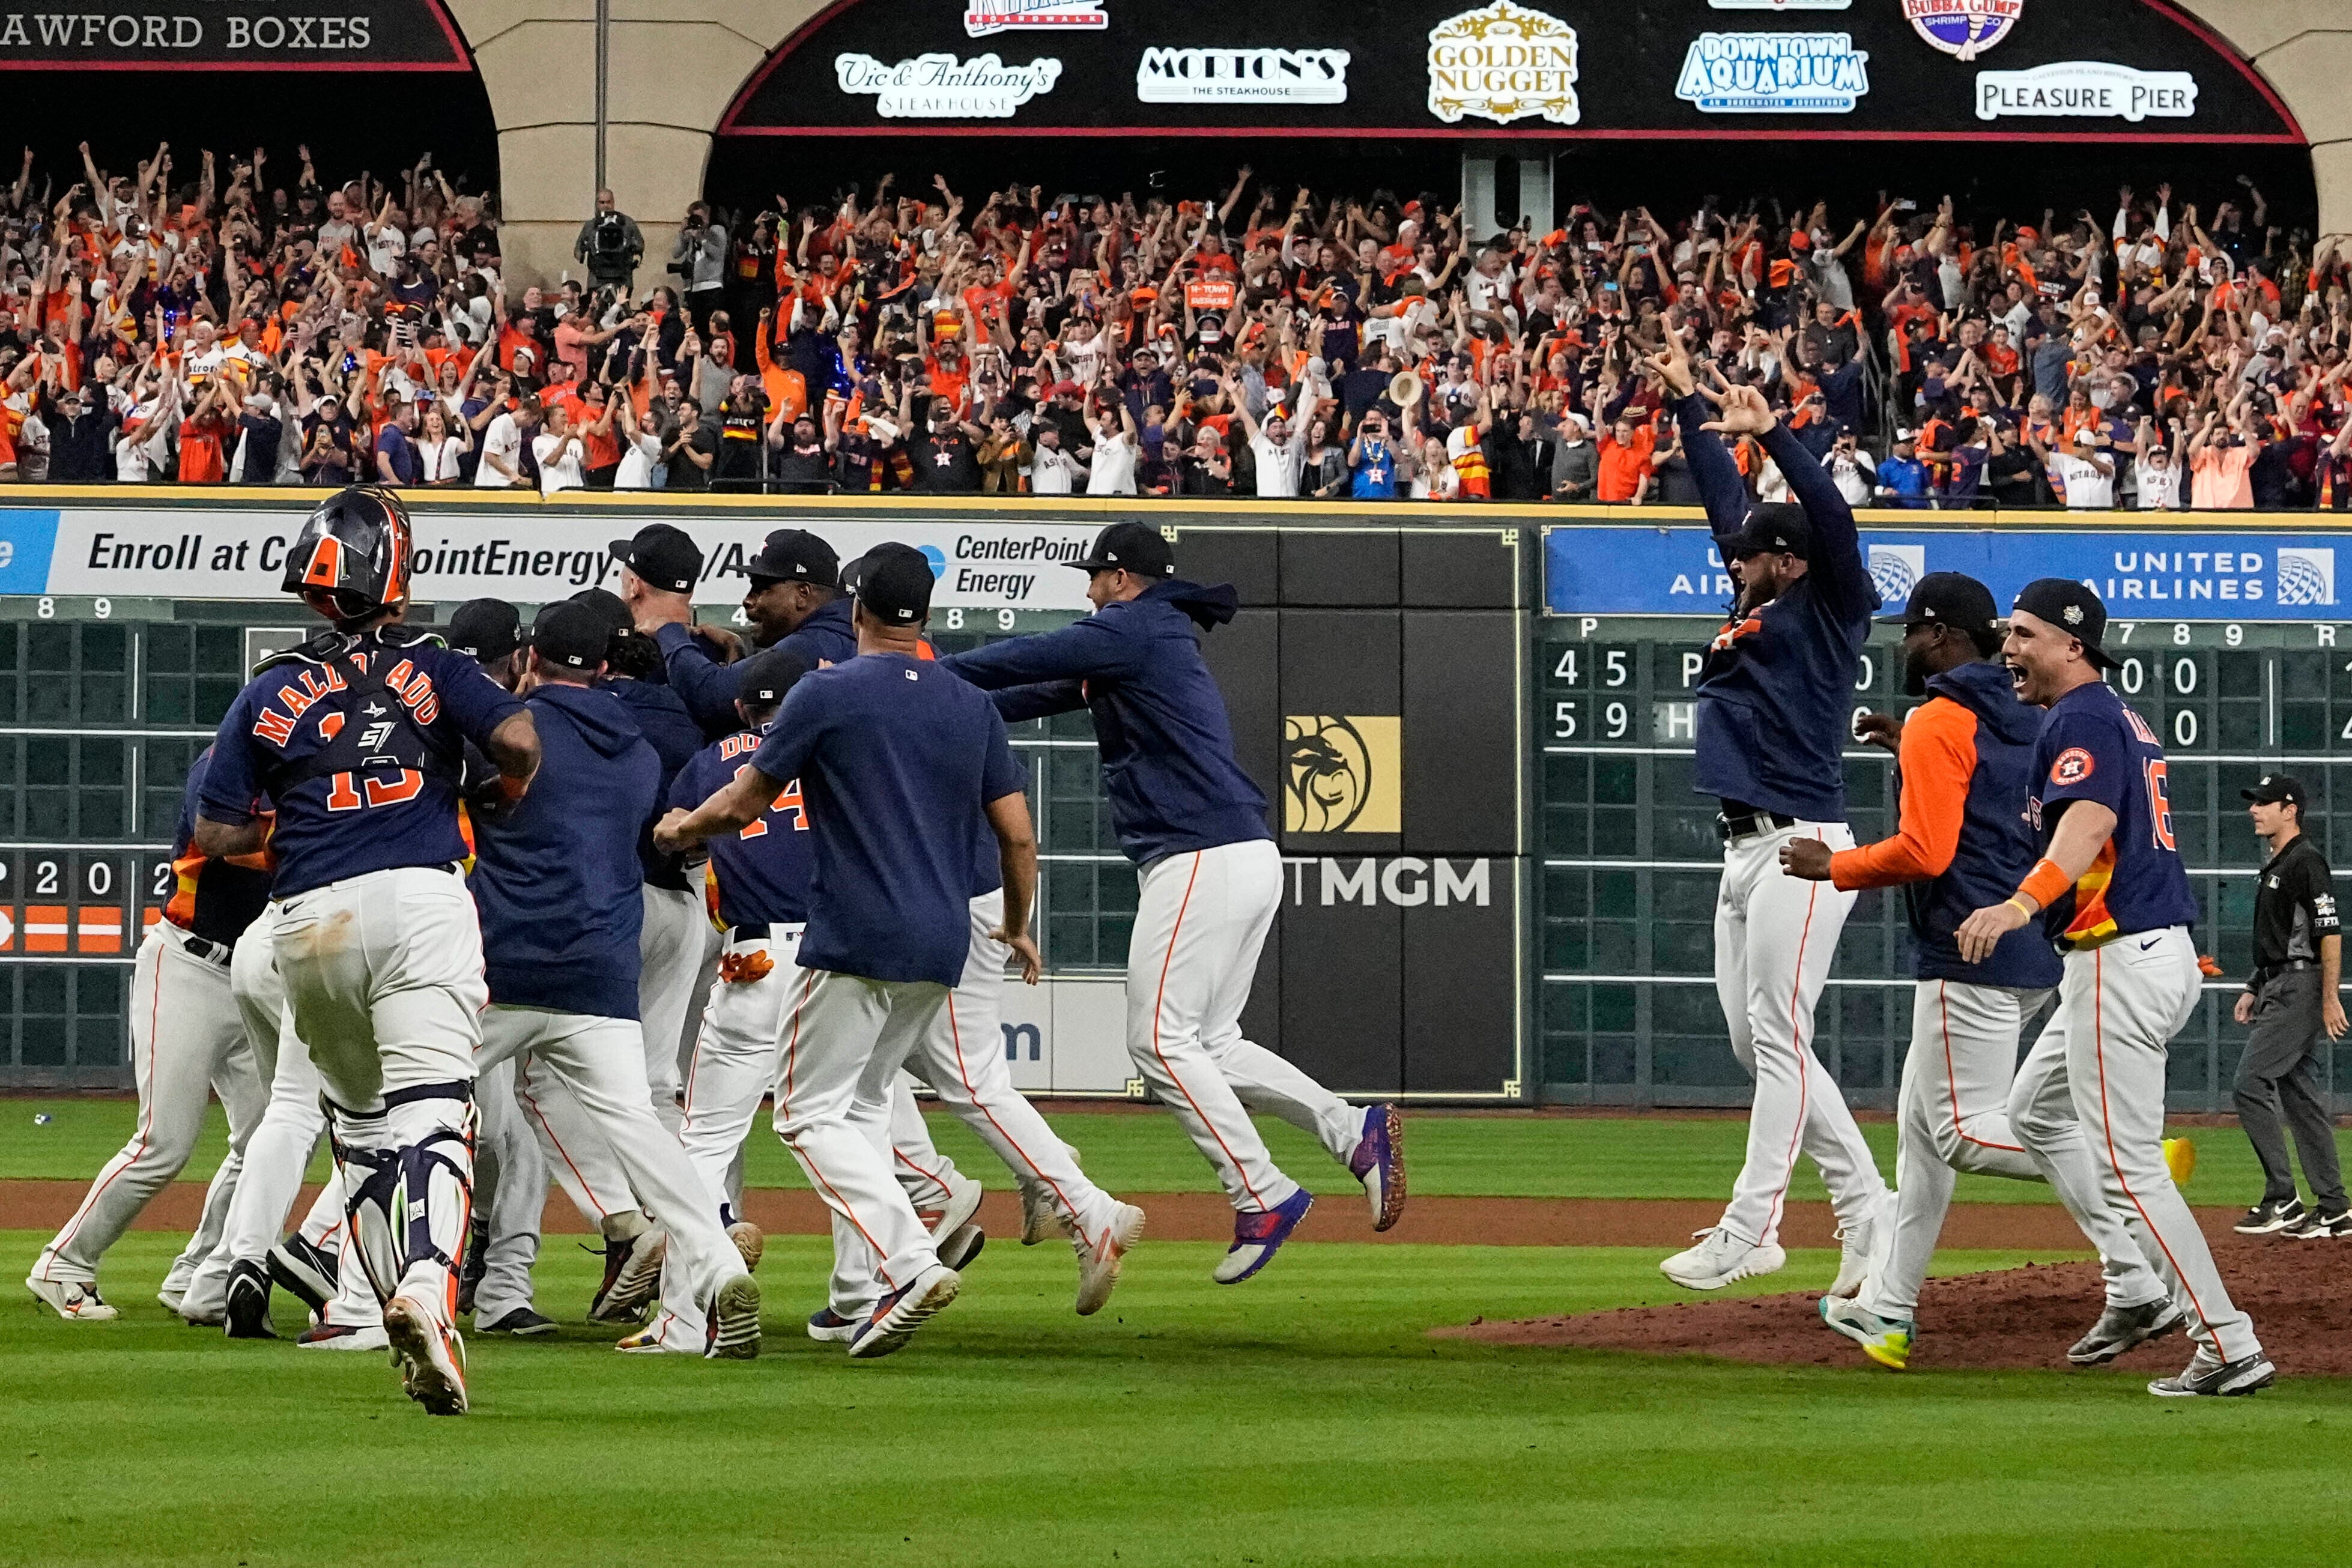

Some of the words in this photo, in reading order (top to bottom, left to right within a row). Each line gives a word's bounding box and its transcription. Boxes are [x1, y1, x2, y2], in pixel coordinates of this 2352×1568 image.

[226, 16, 370, 48] BOXES
[1924, 16, 1967, 26] SHRIMP
[1433, 45, 1572, 68] GOLDEN
[1703, 37, 1847, 61] DOWNTOWN
[842, 60, 887, 86] Vic
[893, 65, 912, 86] &
[917, 61, 1049, 98] Anthony's
[1144, 55, 1336, 80] MORTON'S
[1680, 44, 1865, 97] AQUARIUM
[1193, 87, 1213, 95] THE
[1217, 87, 1291, 96] STEAKHOUSE
[1435, 69, 1572, 92] NUGGET
[884, 96, 1010, 111] STEAKHOUSE
[1984, 84, 2113, 112] PLEASURE
[2132, 86, 2187, 113] PIER
[88, 533, 202, 570] Enroll
[211, 538, 247, 572] at
[956, 535, 1088, 562] CenterPoint
[2115, 552, 2263, 572] UNITED
[957, 569, 1035, 600] Energy
[38, 598, 55, 619] 8
[94, 598, 112, 619] 9
[947, 609, 963, 629] 8
[998, 609, 1015, 629] 9
[1581, 618, 1598, 638] P
[2118, 623, 2135, 644] 7
[2173, 623, 2191, 645] 8
[2225, 624, 2244, 646] 9
[2316, 625, 2336, 647] R
[2121, 658, 2144, 694] 0
[2174, 658, 2197, 694] 0
[2175, 710, 2198, 746] 0
